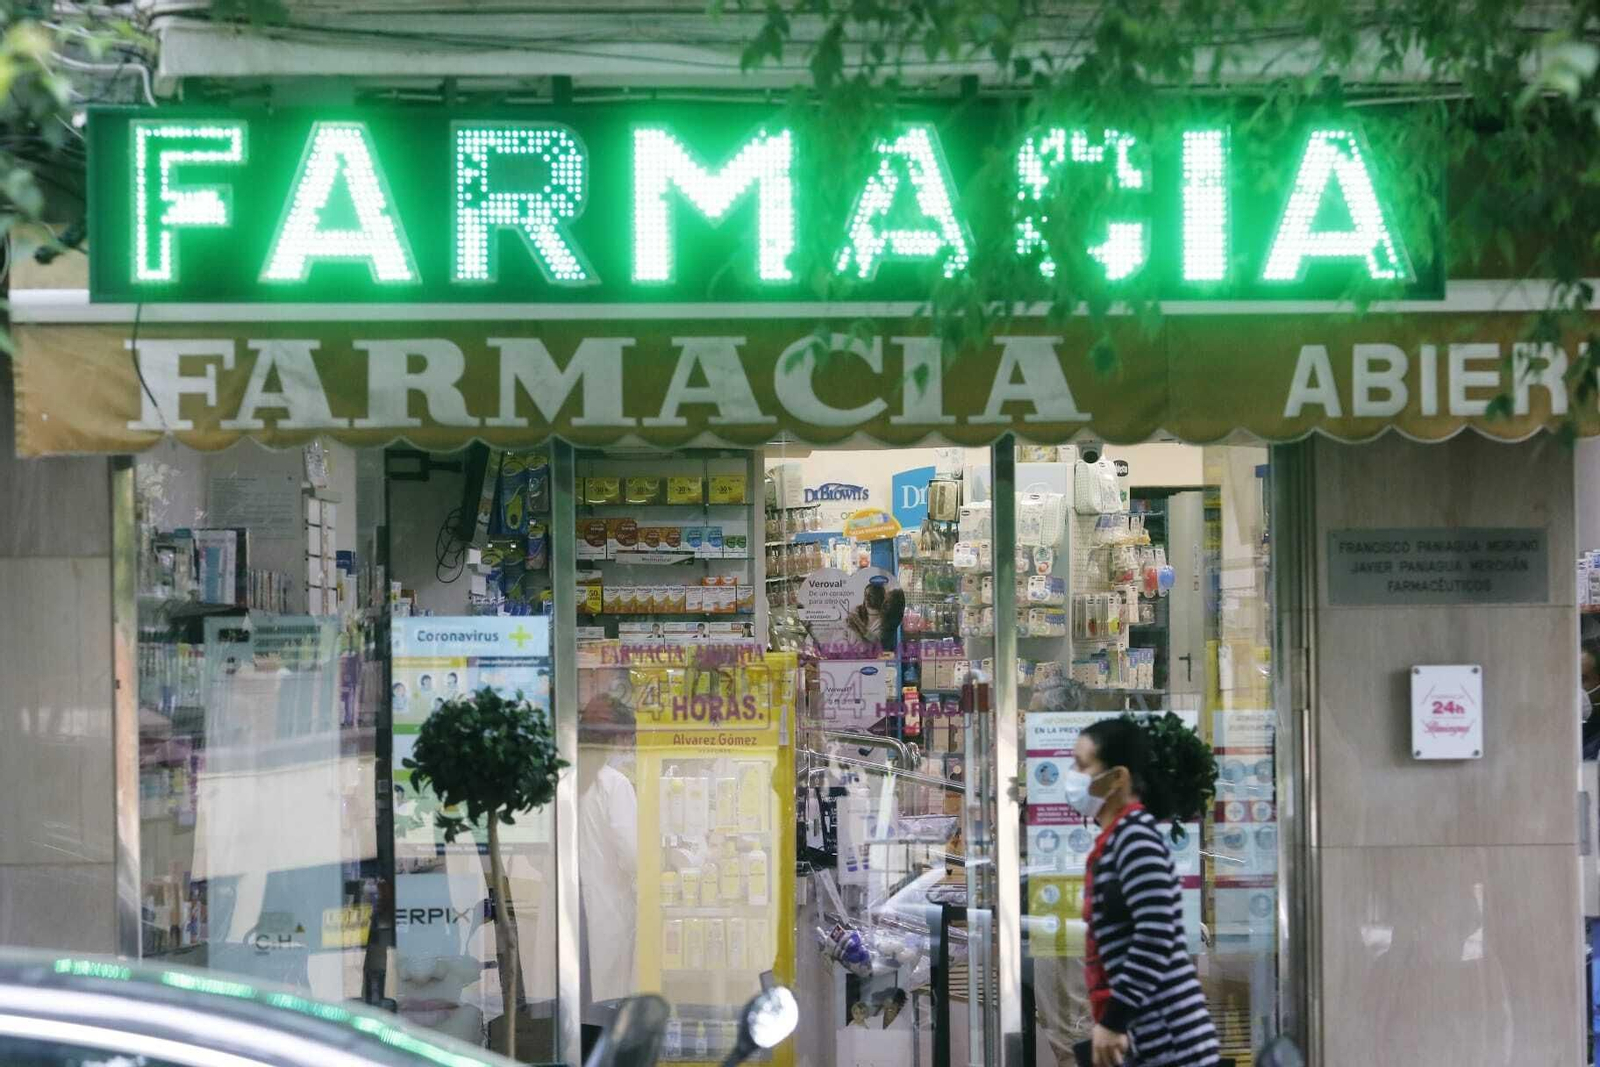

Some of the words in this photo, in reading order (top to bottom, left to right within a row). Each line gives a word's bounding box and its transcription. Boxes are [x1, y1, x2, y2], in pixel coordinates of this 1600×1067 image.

[130, 120, 1416, 284] FARMACIA
[125, 334, 1092, 431] FARMACIA
[1284, 342, 1600, 418] ABIER
[1339, 540, 1411, 554] FRANCISCO
[1349, 560, 1393, 574] JAVIER
[1399, 559, 1462, 573] PANIAGUA
[1387, 578, 1492, 592] FARMACÉUTICOS
[417, 630, 499, 642] Coronavirus
[672, 694, 765, 722] HORAS.
[1432, 701, 1466, 714] 24h
[718, 732, 757, 746] Gómez
